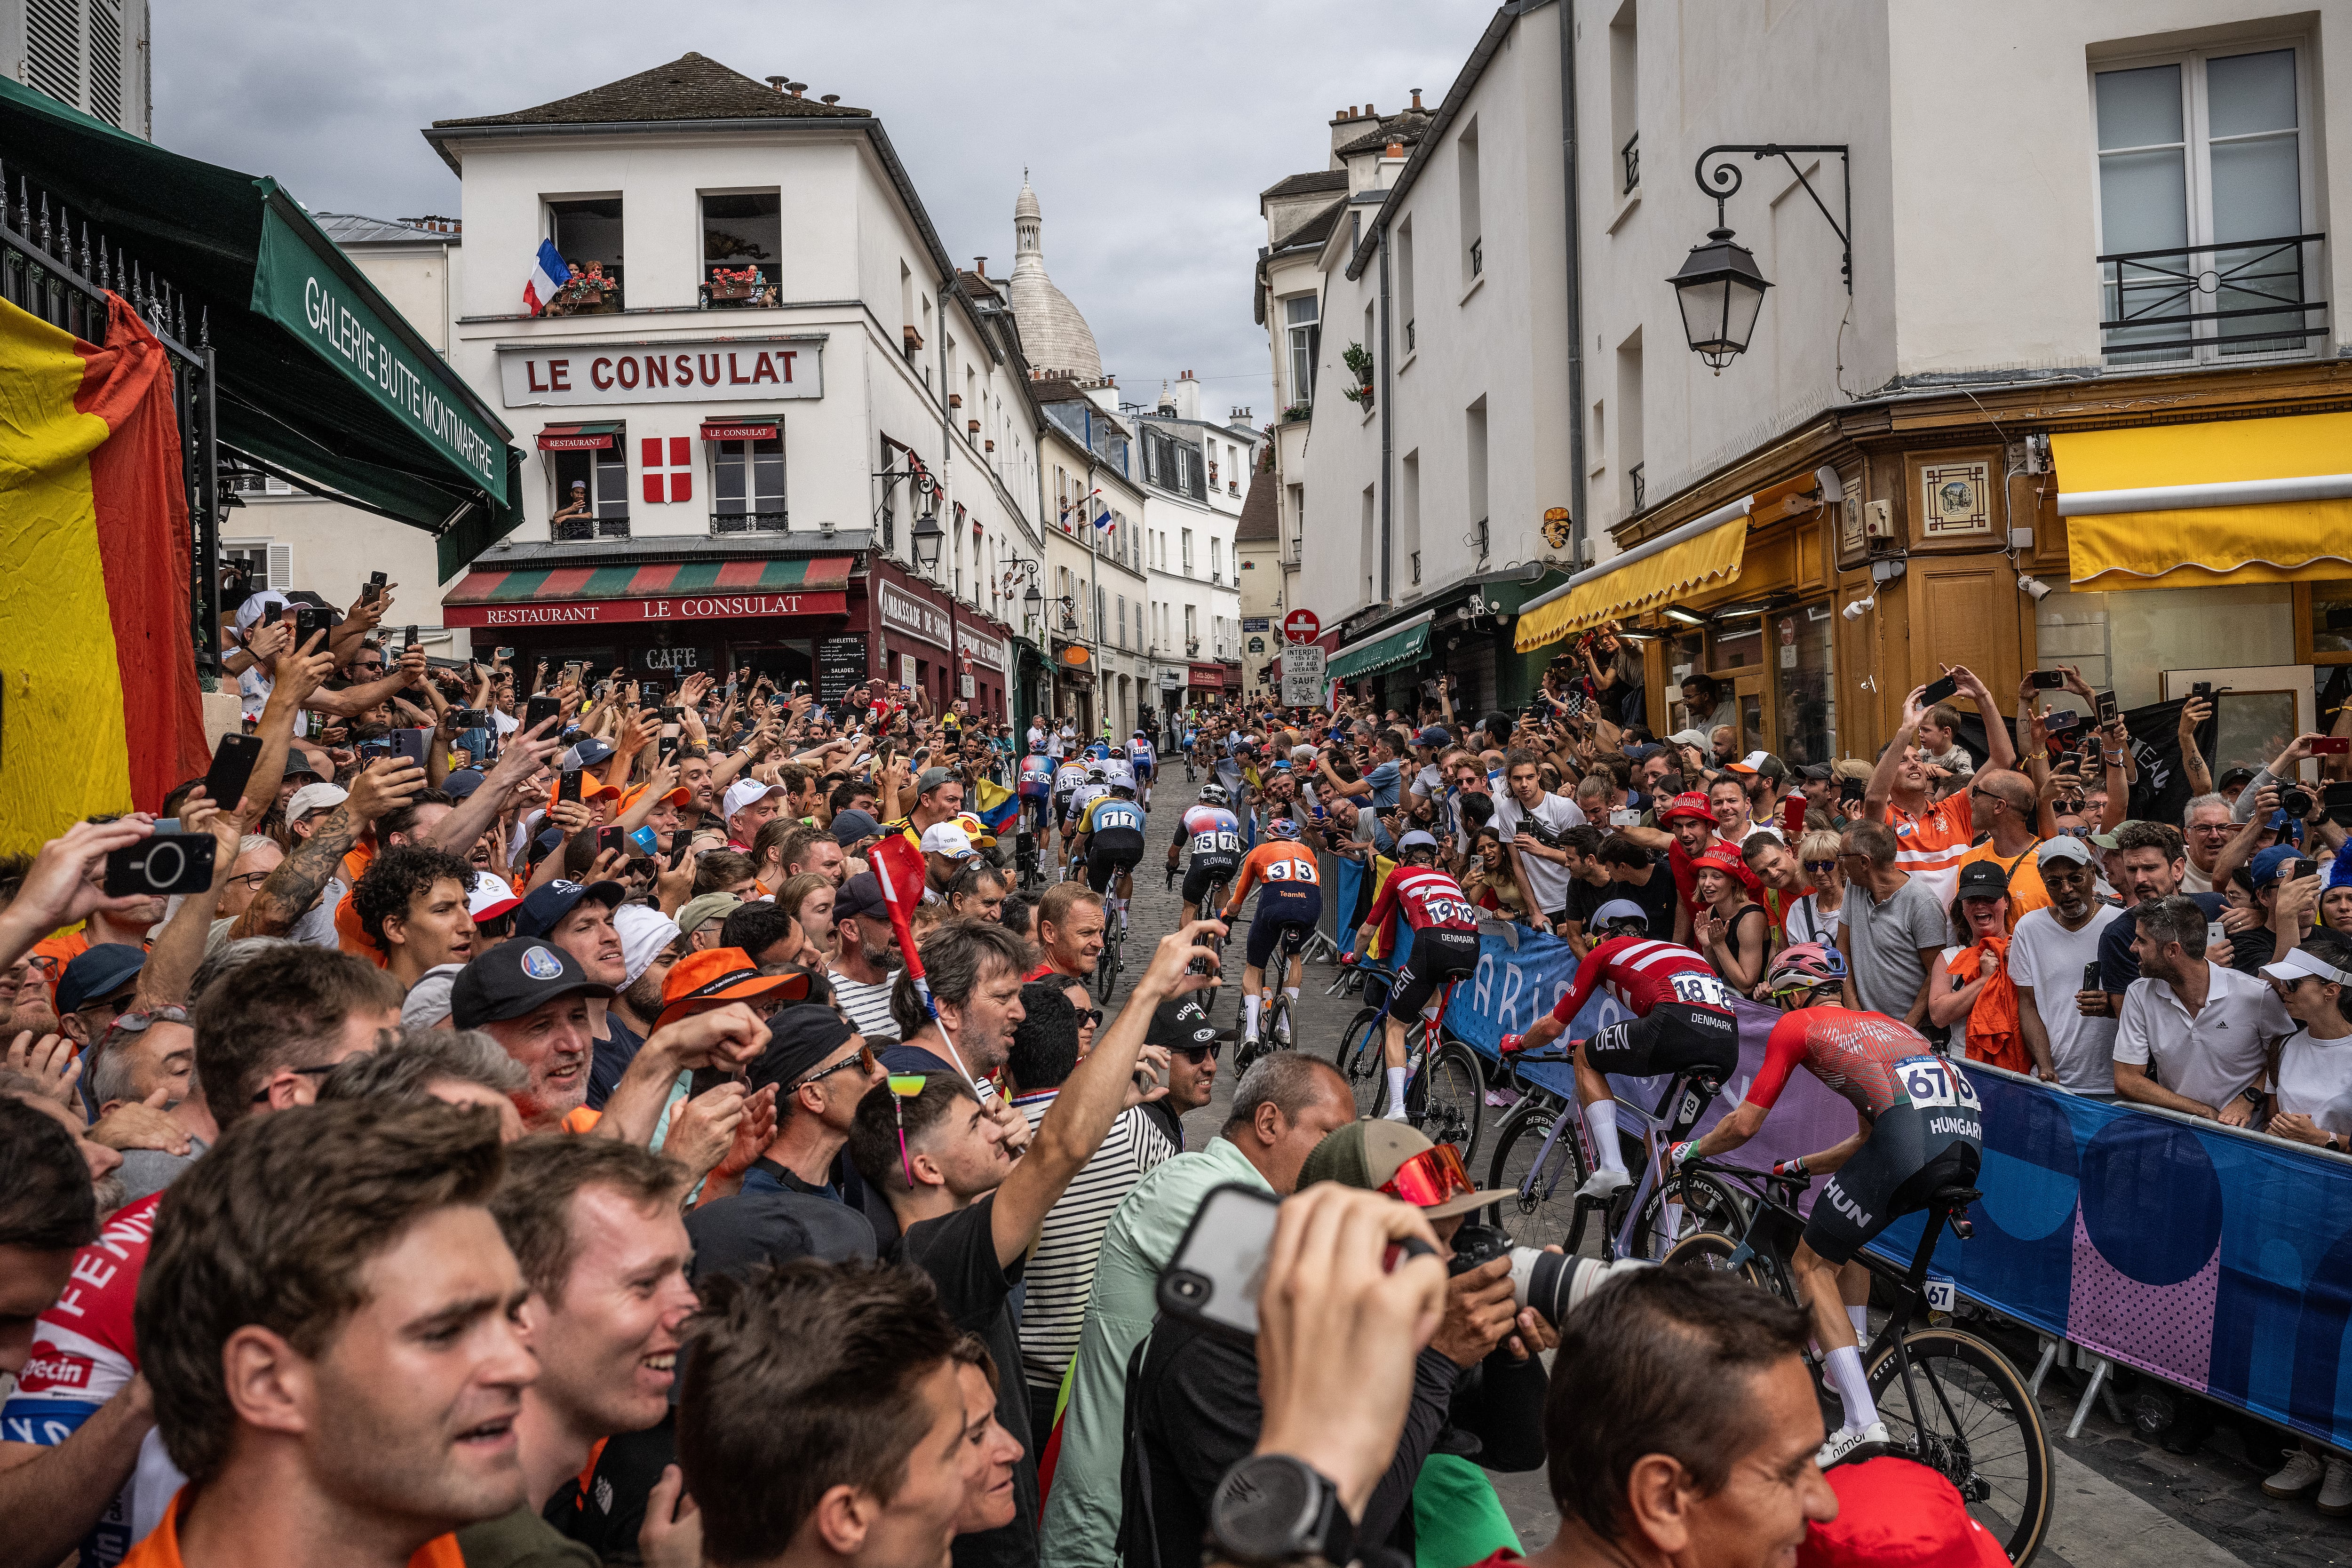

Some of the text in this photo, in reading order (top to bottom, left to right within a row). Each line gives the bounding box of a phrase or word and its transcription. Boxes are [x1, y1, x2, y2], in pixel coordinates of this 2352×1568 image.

[305, 277, 493, 479] GALERIE BUTTE MONTMARTRE
[525, 350, 797, 392] LE CONSULAT
[549, 438, 601, 447] RESTAURANT
[723, 428, 767, 438] CONSULAT
[486, 595, 802, 624] RESTAURANT LE CONSULAT
[883, 592, 950, 642] AMBASSADE DE SAVOIE
[646, 648, 696, 669] CAFE
[980, 641, 985, 659] LE
[1039, 774, 1050, 783] 24
[1059, 777, 1083, 789] 15 15
[1673, 797, 1705, 810] ANMARK
[1105, 813, 1131, 825] 7 7
[1196, 835, 1238, 852] 75 75
[1203, 856, 1232, 866] SLOVAKIA
[1272, 865, 1311, 879] 3 3
[1429, 902, 1475, 924] 19 19
[1441, 933, 1475, 944] DENMARK
[1392, 966, 1415, 1000] DEN
[1674, 979, 1706, 1001] 18
[1345, 1020, 1357, 1041] AEOLUS
[1691, 1013, 1732, 1032] DENMARK
[1596, 1023, 1631, 1051] DEN
[1907, 1068, 1973, 1099] 67 6
[1684, 1098, 1696, 1116] 18
[1930, 1116, 1982, 1141] HUNGARY
[1824, 1175, 1872, 1229] HUN
[1928, 1286, 1949, 1305] 67
